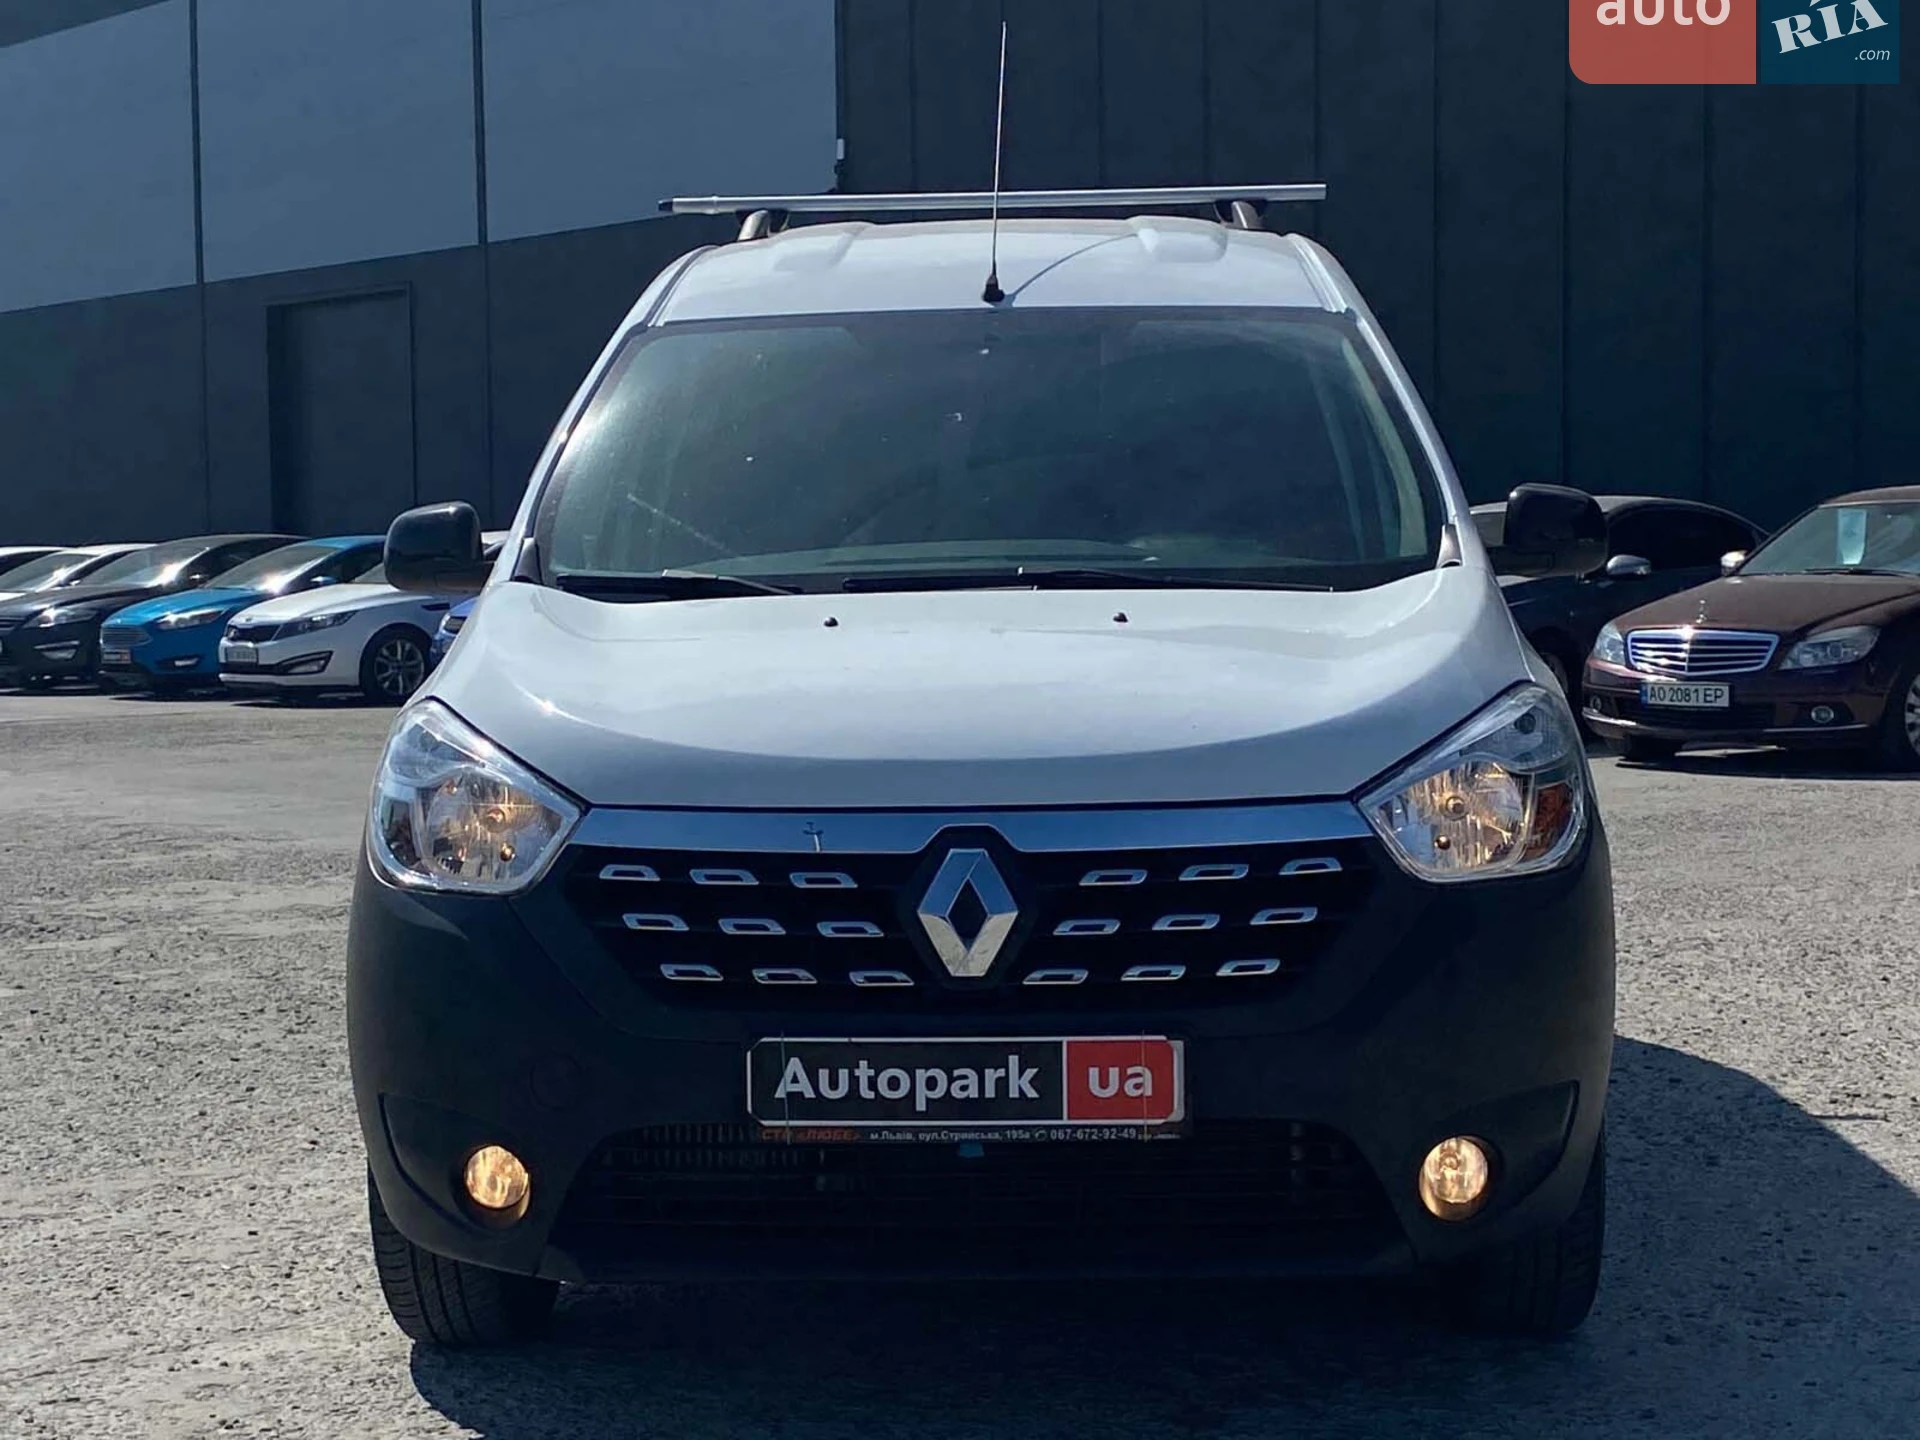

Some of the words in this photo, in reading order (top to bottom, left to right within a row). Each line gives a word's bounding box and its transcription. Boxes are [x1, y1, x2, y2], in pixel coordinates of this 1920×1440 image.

[1668, 687, 1700, 703] 2081
[774, 1054, 1040, 1112] Autopark
[1088, 1064, 1154, 1098] ua
